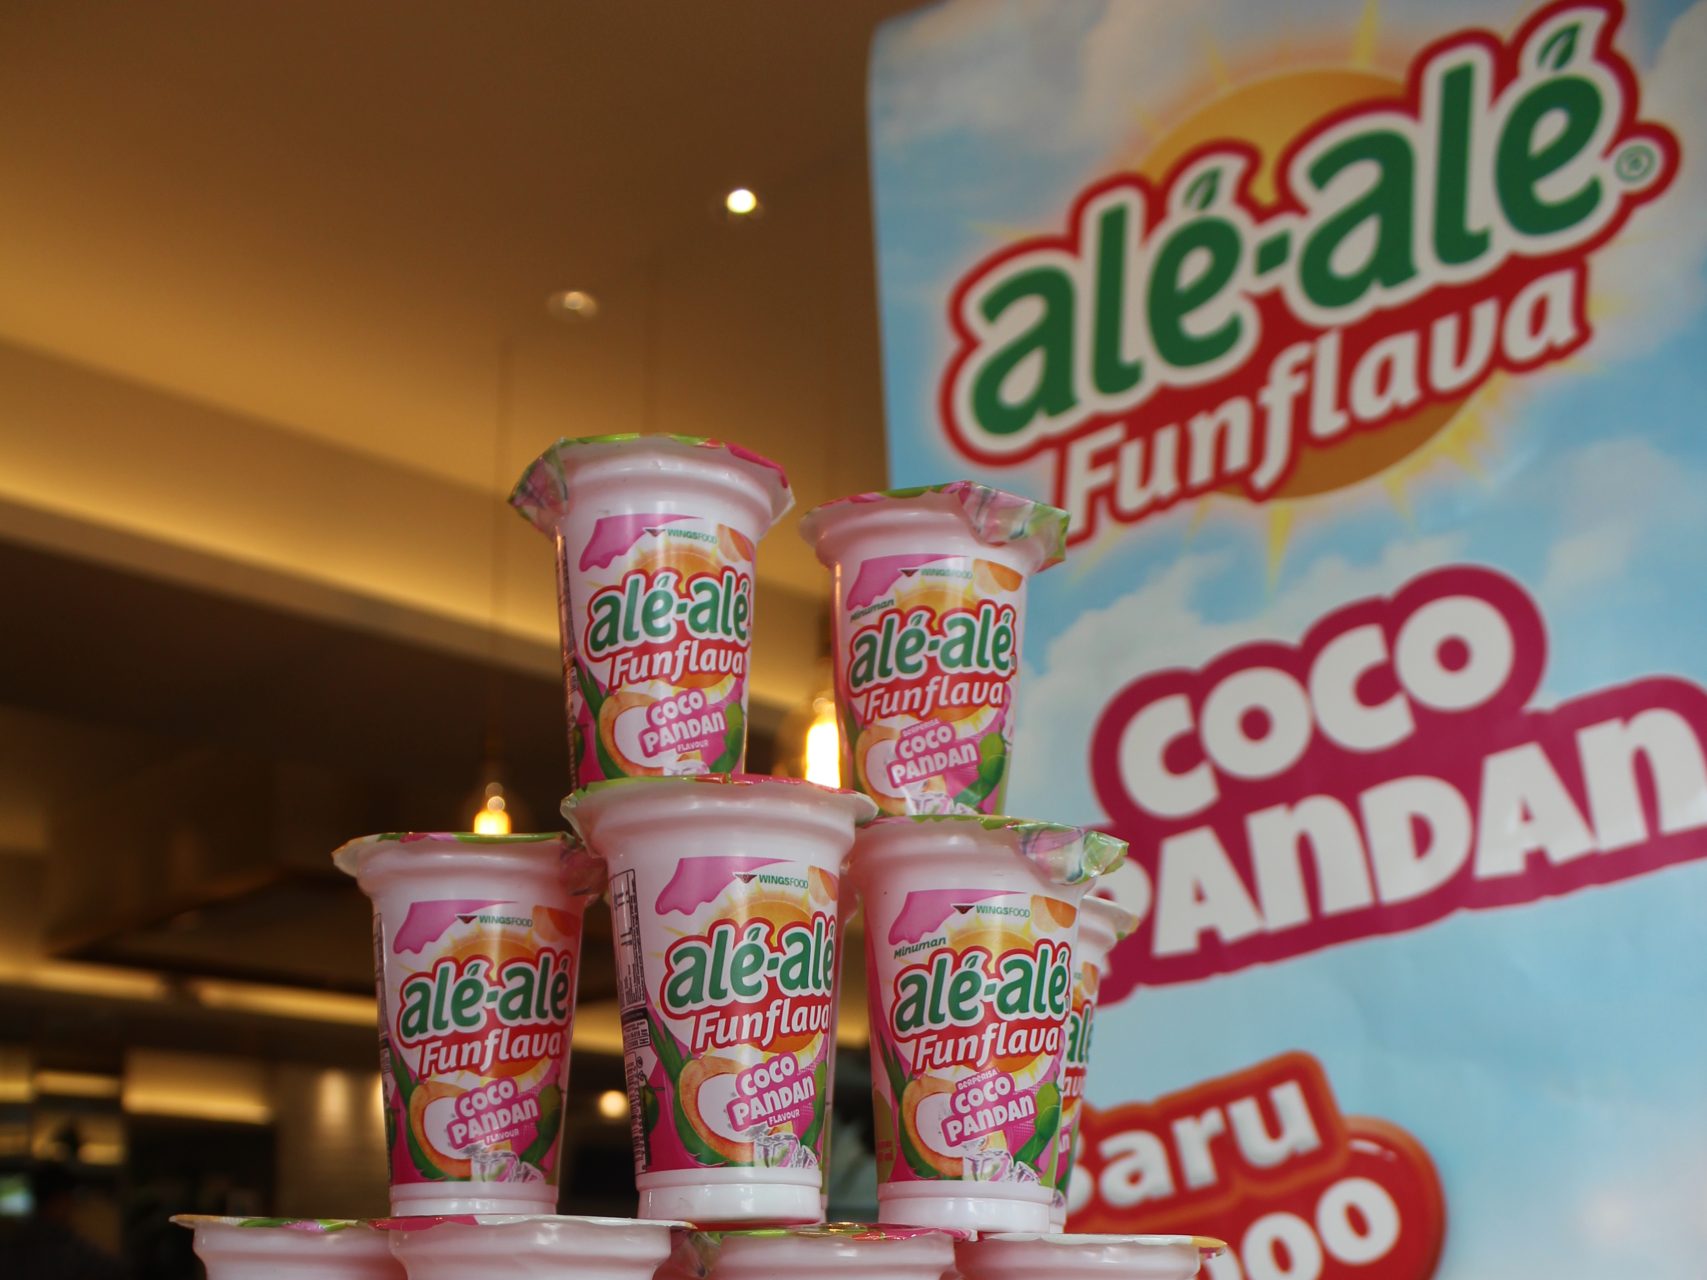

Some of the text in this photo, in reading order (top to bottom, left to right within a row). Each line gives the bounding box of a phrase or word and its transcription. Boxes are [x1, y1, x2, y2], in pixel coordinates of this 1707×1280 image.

[972, 23, 1603, 435] alé-alé
[1066, 270, 1577, 529] Funflava
[589, 575, 748, 652] alé-alé
[613, 641, 742, 687] Funflava
[851, 609, 1012, 687] alé-alé
[651, 692, 702, 726] COCO
[867, 675, 1004, 719] Funflava
[1118, 596, 1515, 818] COCO
[643, 711, 725, 752] PANDAN
[900, 726, 951, 759] COCO
[891, 743, 977, 784] PANDAN
[759, 875, 808, 889] WINGSFOOD
[479, 915, 532, 927] WINGSFOOD
[976, 905, 1030, 918] WINGSFOOD
[894, 937, 946, 958] Minuman
[401, 957, 568, 1037] alé-alé
[895, 949, 1067, 1031] alé-alé
[696, 999, 829, 1049] Funflava
[916, 1022, 1059, 1071] Funflava
[422, 1029, 561, 1076] Funflava
[460, 1081, 513, 1117] COCO
[741, 1056, 794, 1096] COCO
[955, 1078, 1010, 1113] COCO
[452, 1097, 538, 1144] PANDAN
[734, 1077, 814, 1125] PANDAN
[769, 1110, 800, 1126] FLAVOUR
[947, 1095, 1034, 1142] PANDAN
